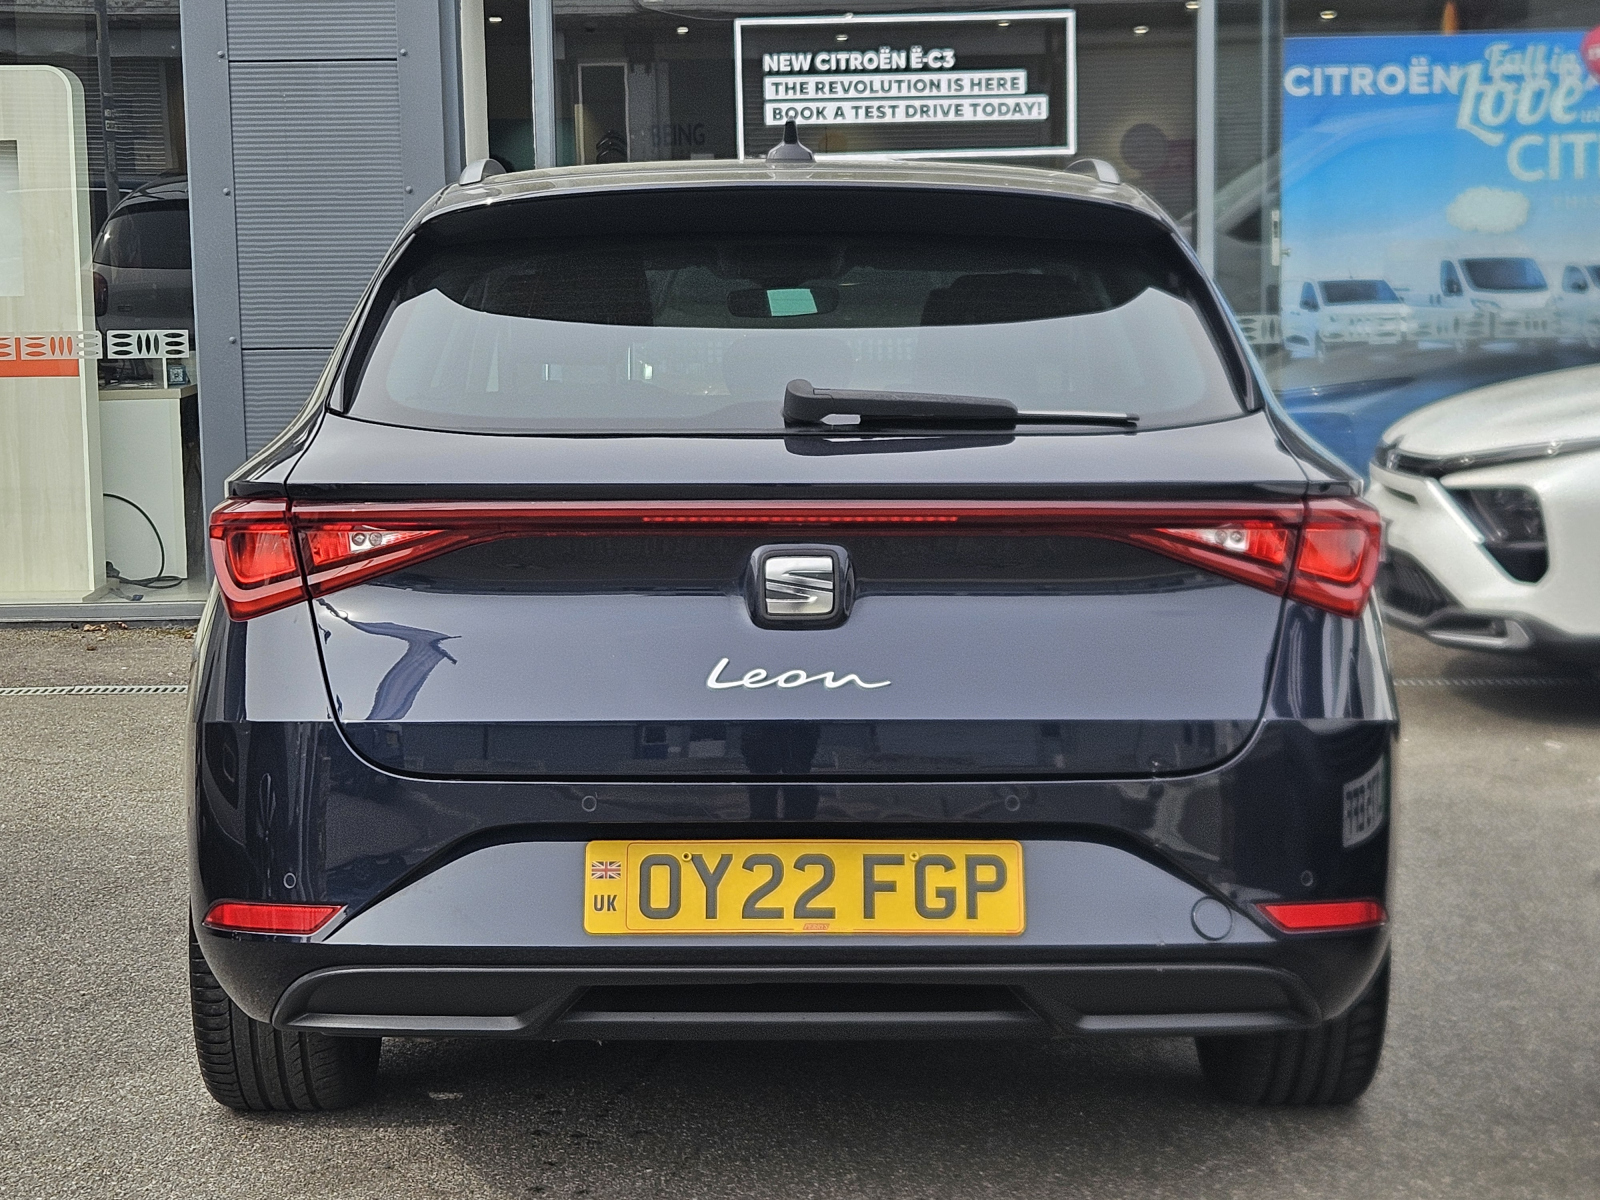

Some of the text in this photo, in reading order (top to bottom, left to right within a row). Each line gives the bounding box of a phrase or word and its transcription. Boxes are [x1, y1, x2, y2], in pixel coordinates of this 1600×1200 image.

[764, 46, 956, 72] NEW CITROËN Ë-C3
[1484, 41, 1547, 77] Fall
[771, 76, 1021, 96] THE REVOLUTION IS HERE
[1284, 57, 1459, 96] CITROËN
[772, 101, 1042, 121] BOOK A TEST DRIVE TODAY!
[1456, 62, 1584, 147] Love
[1506, 132, 1600, 182] CIT
[707, 658, 891, 689] Leon
[593, 894, 618, 912] UK
[638, 853, 1008, 920] OY22 FGP
